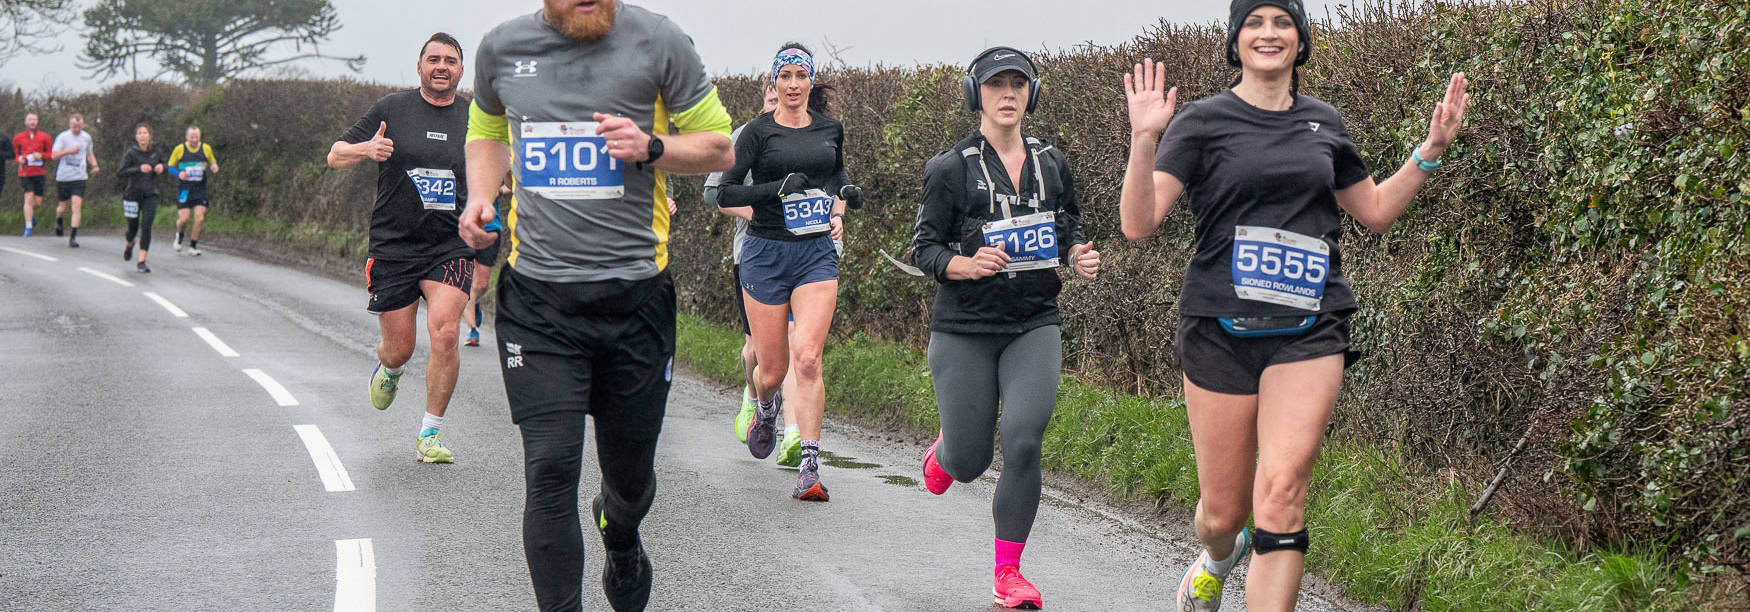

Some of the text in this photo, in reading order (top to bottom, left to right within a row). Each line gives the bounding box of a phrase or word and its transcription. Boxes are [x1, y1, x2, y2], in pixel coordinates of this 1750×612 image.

[525, 141, 617, 171] 5101
[549, 177, 598, 186] R ROBERTS
[784, 199, 833, 221] 5343
[988, 226, 1055, 253] 5126
[1236, 244, 1326, 283] 5555
[1241, 277, 1317, 297] SIONED ROWLANDS
[507, 355, 524, 369] RR
